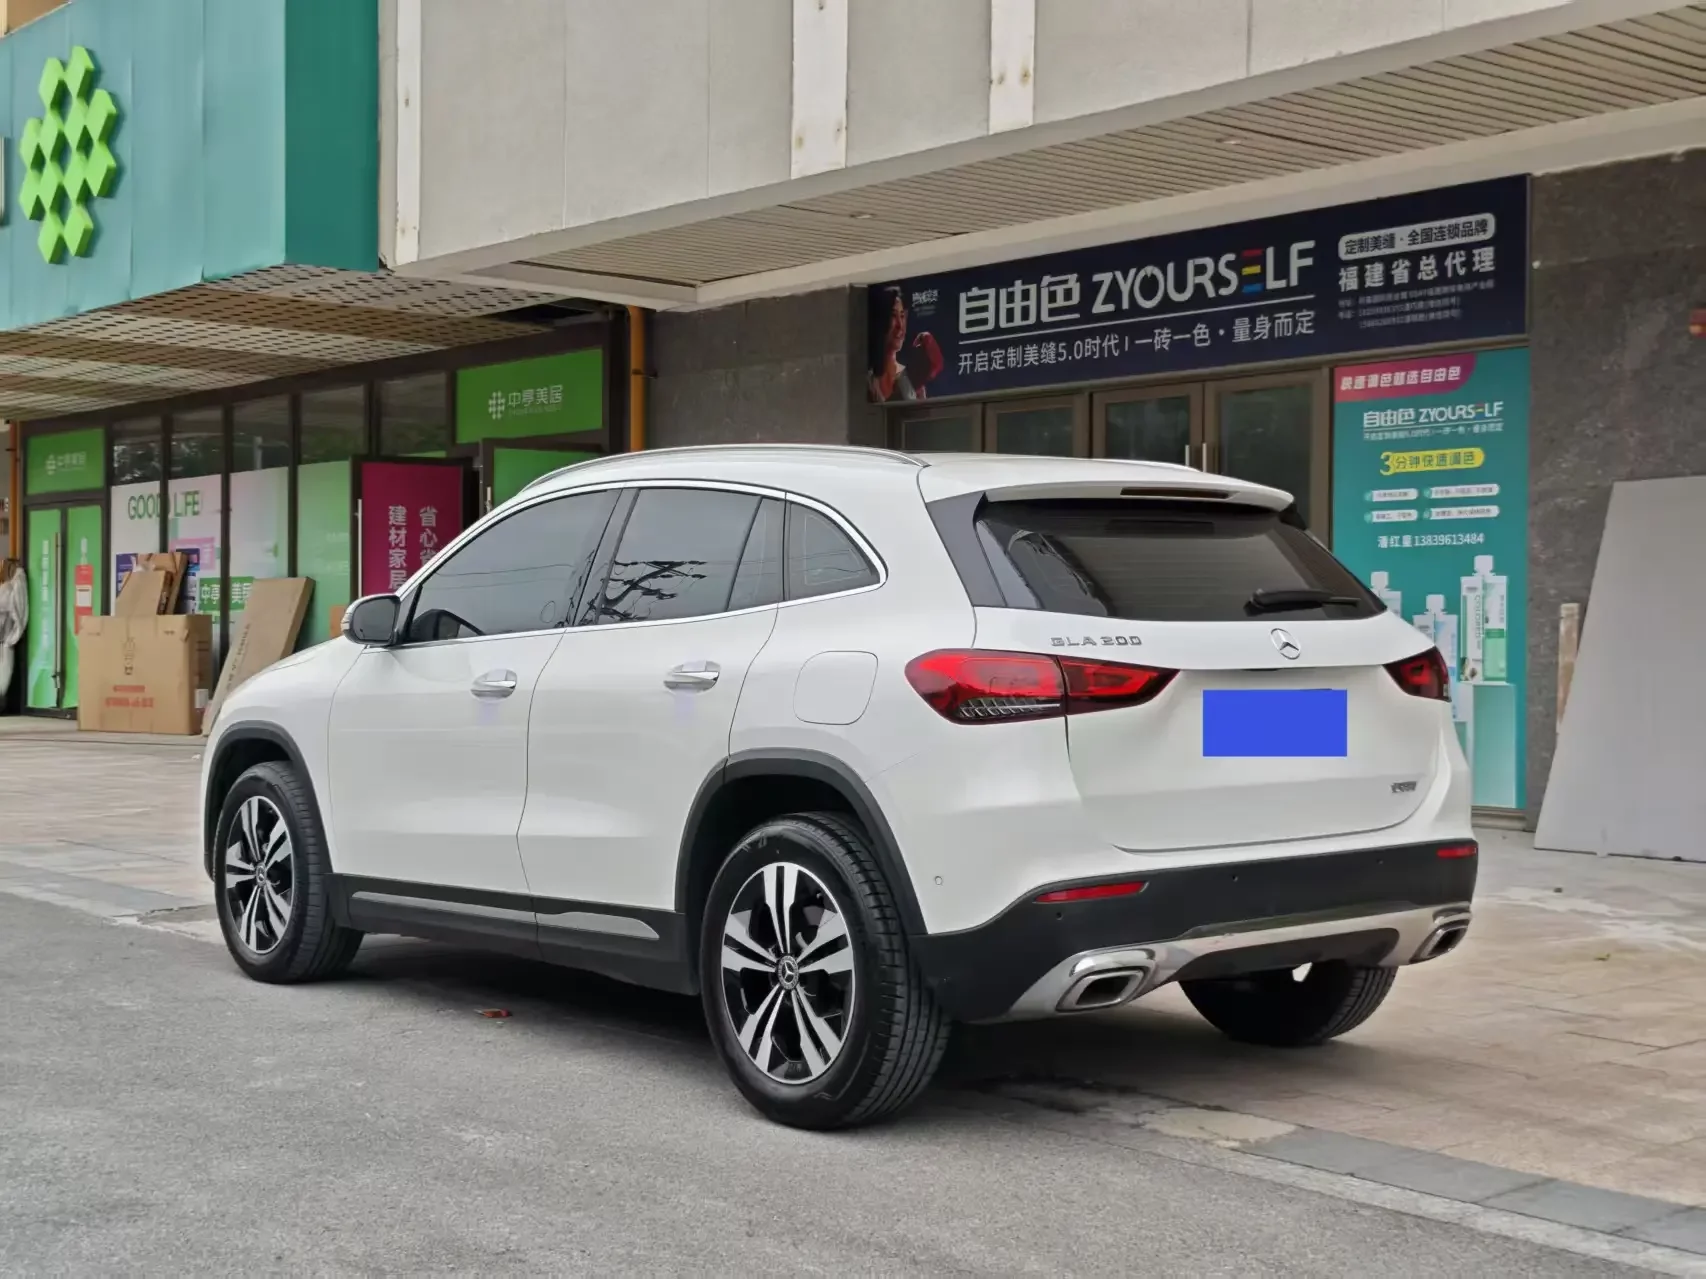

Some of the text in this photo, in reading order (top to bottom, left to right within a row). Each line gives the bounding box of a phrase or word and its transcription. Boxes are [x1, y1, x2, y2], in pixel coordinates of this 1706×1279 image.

[958, 240, 1317, 334] 自由色 ZYOURSELF
[1338, 246, 1496, 292] 福建省总代理
[1363, 401, 1504, 429] 自由色 ZYOURSELF
[1050, 635, 1142, 647] GLA 200
